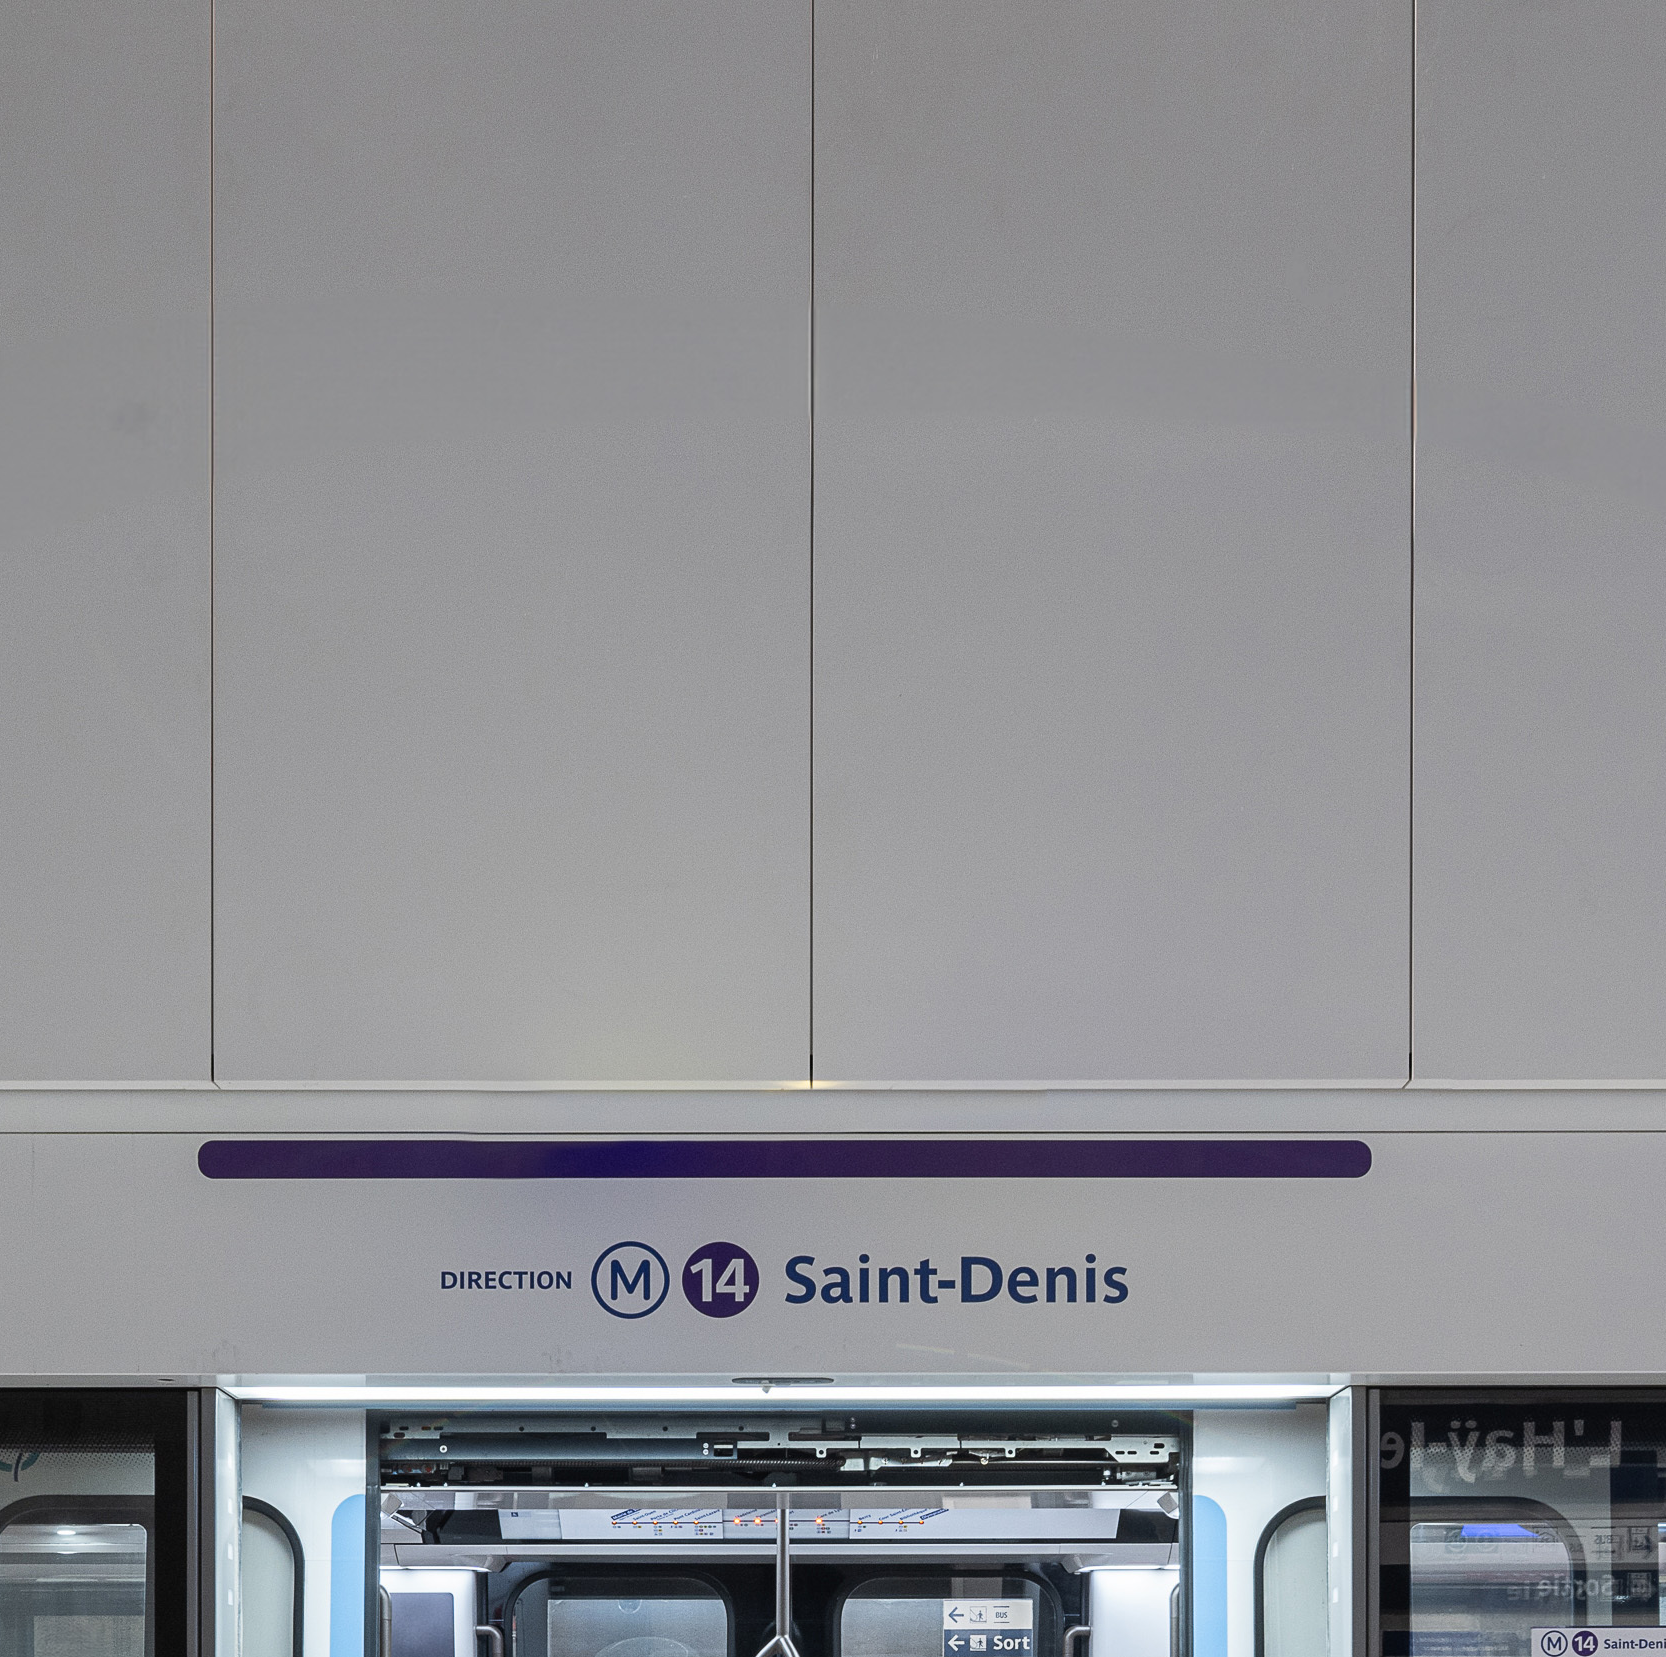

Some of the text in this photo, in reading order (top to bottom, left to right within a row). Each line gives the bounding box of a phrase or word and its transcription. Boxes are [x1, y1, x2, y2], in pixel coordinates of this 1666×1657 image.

[440, 1270, 572, 1290] DIRECTION
[690, 1258, 750, 1302] 14
[784, 1253, 1129, 1304] Saint-Denis
[995, 1611, 1008, 1619] BUS
[1574, 1635, 1596, 1651] 14
